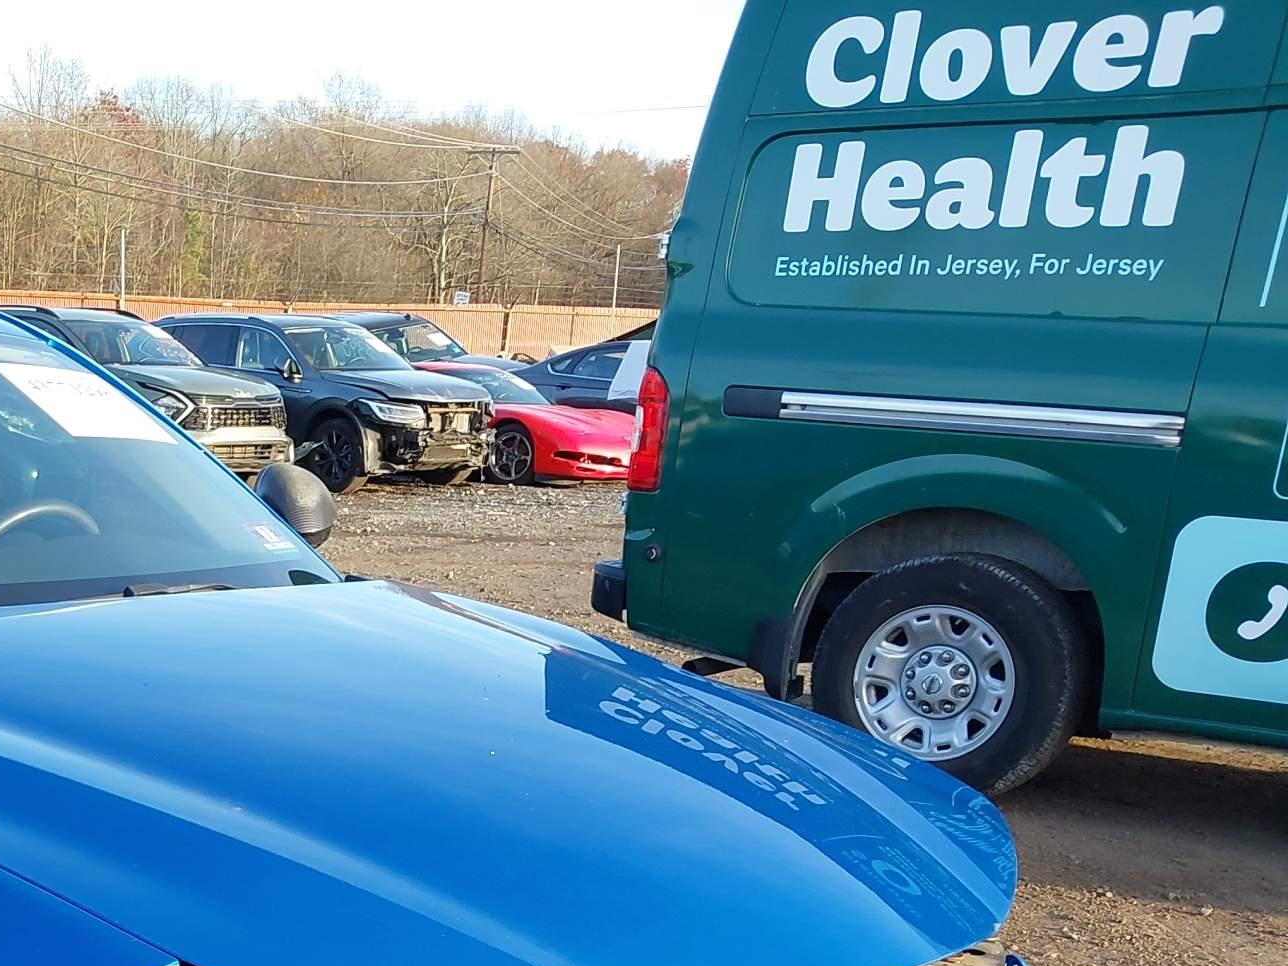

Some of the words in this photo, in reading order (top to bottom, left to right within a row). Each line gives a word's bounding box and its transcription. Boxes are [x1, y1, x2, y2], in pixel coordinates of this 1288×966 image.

[805, 5, 1225, 108] Clover
[783, 125, 1185, 232] Health
[774, 253, 903, 277] Established
[908, 253, 930, 276] In
[936, 253, 1021, 280] Jersey,
[1028, 252, 1070, 276] For
[1075, 252, 1165, 281] Jersey
